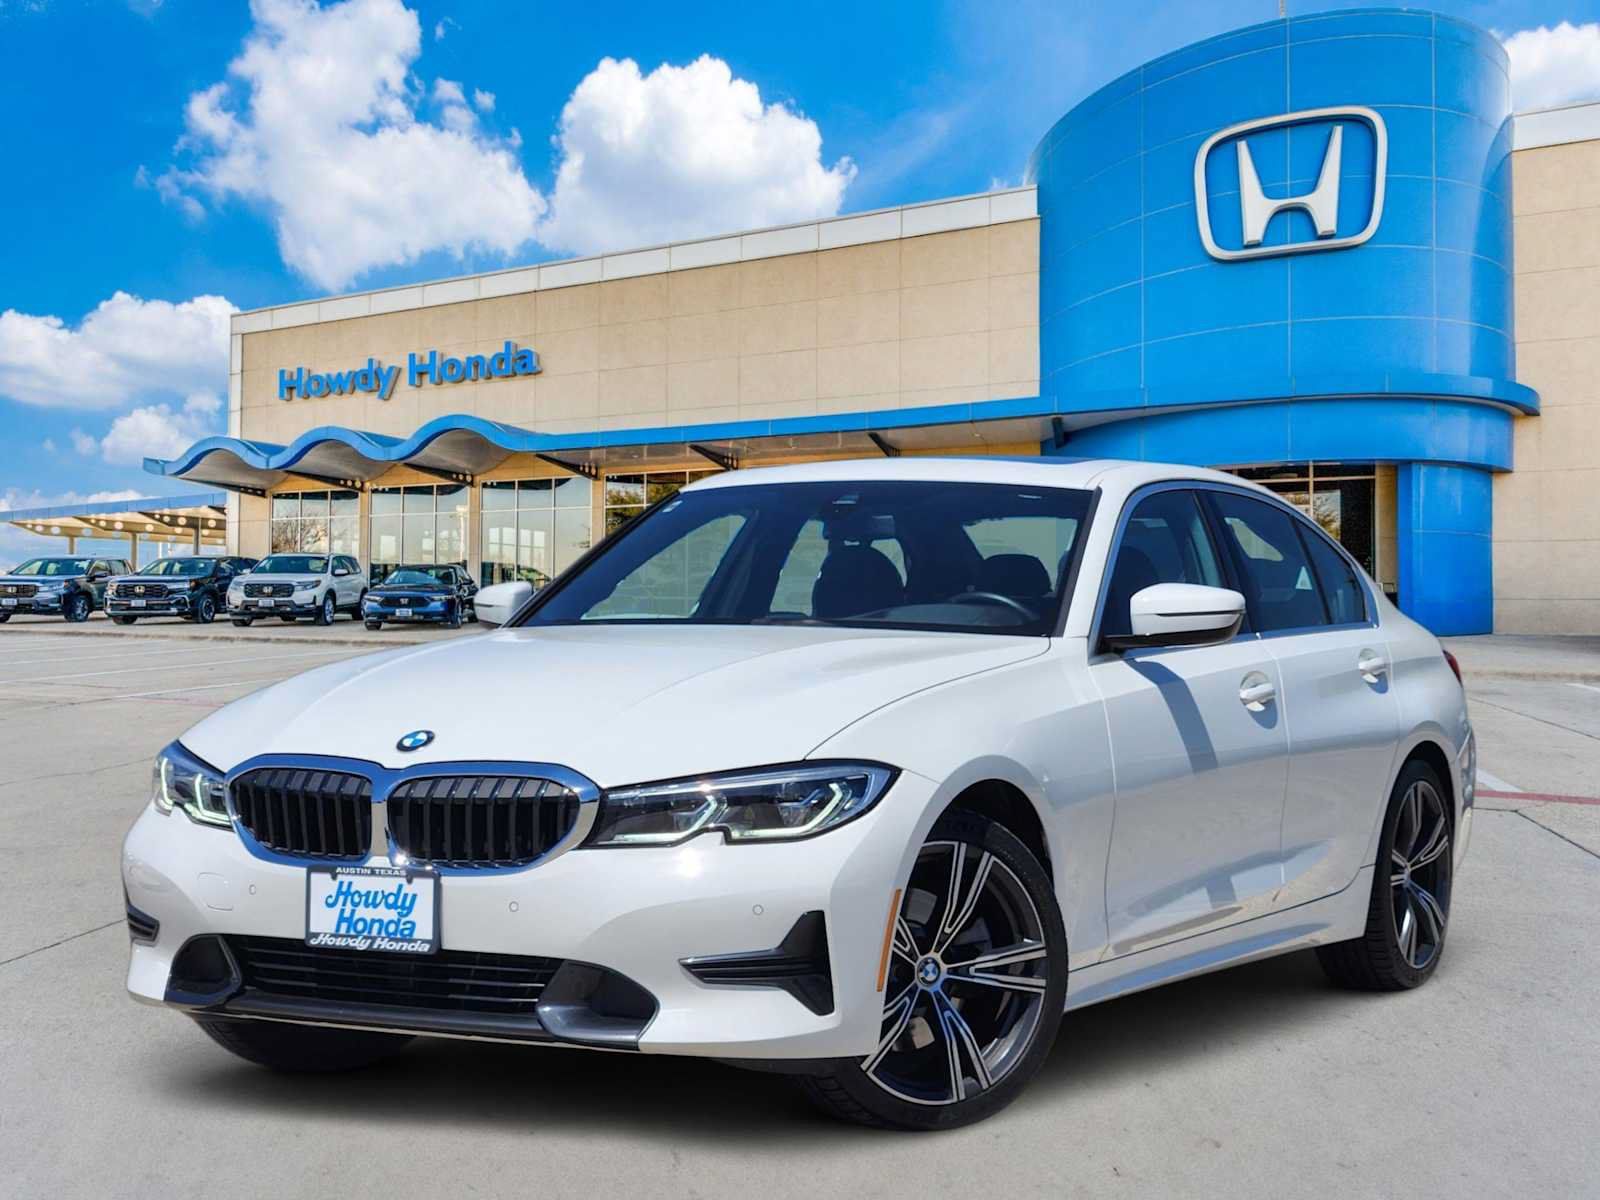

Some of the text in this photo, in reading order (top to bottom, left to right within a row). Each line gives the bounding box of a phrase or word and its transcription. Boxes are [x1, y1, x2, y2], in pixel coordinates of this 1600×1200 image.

[278, 341, 541, 401] Howdy Honda
[335, 867, 407, 876] AUSTIN TEXAS
[325, 880, 417, 918] Howdy
[335, 908, 417, 939] Honda
[310, 934, 431, 952] Howdy Honda
